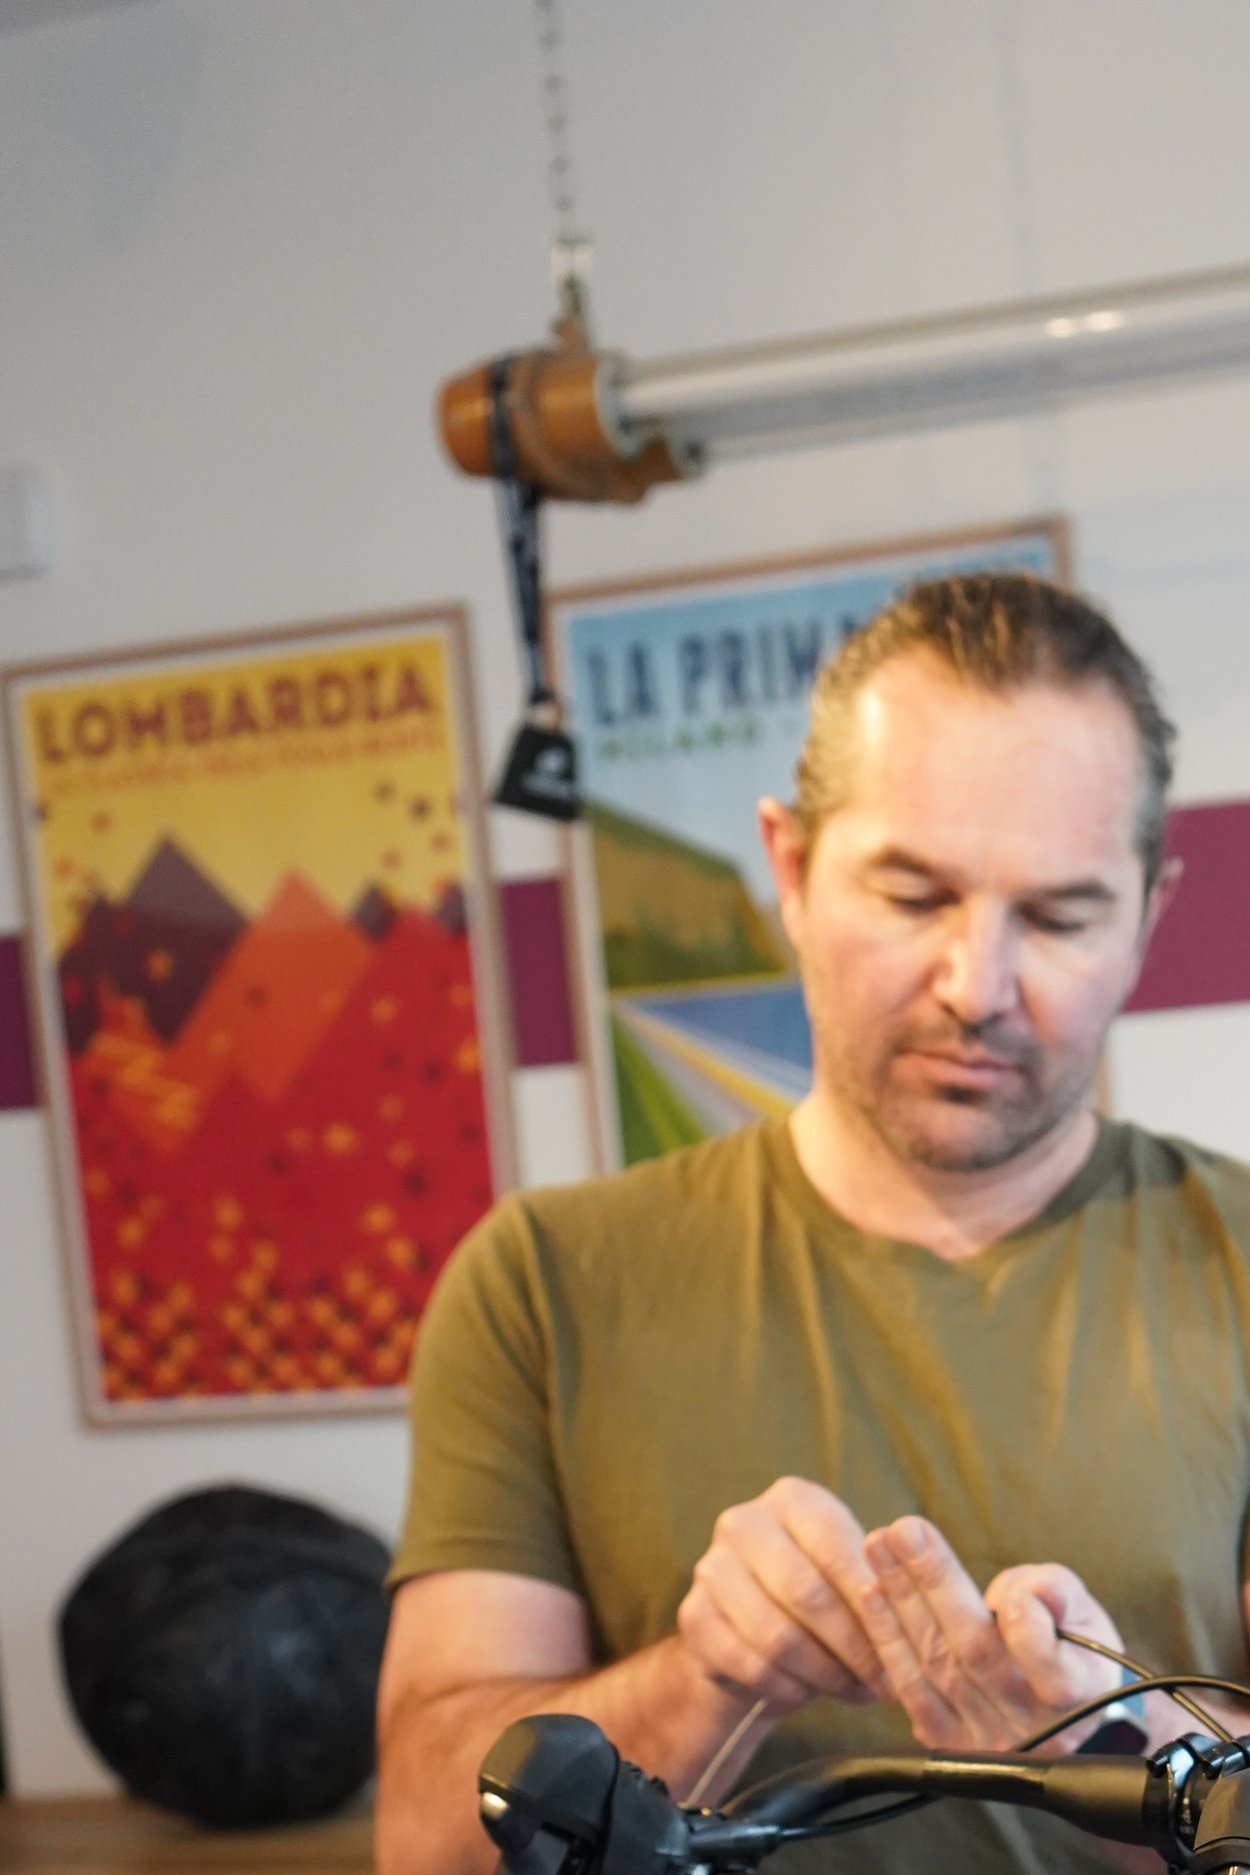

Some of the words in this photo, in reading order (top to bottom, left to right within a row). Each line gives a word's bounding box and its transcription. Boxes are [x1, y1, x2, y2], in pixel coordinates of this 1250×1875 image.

[34, 660, 435, 764] LOMBARDIA
[586, 638, 660, 728] LA
[674, 612, 862, 717] PRIM
